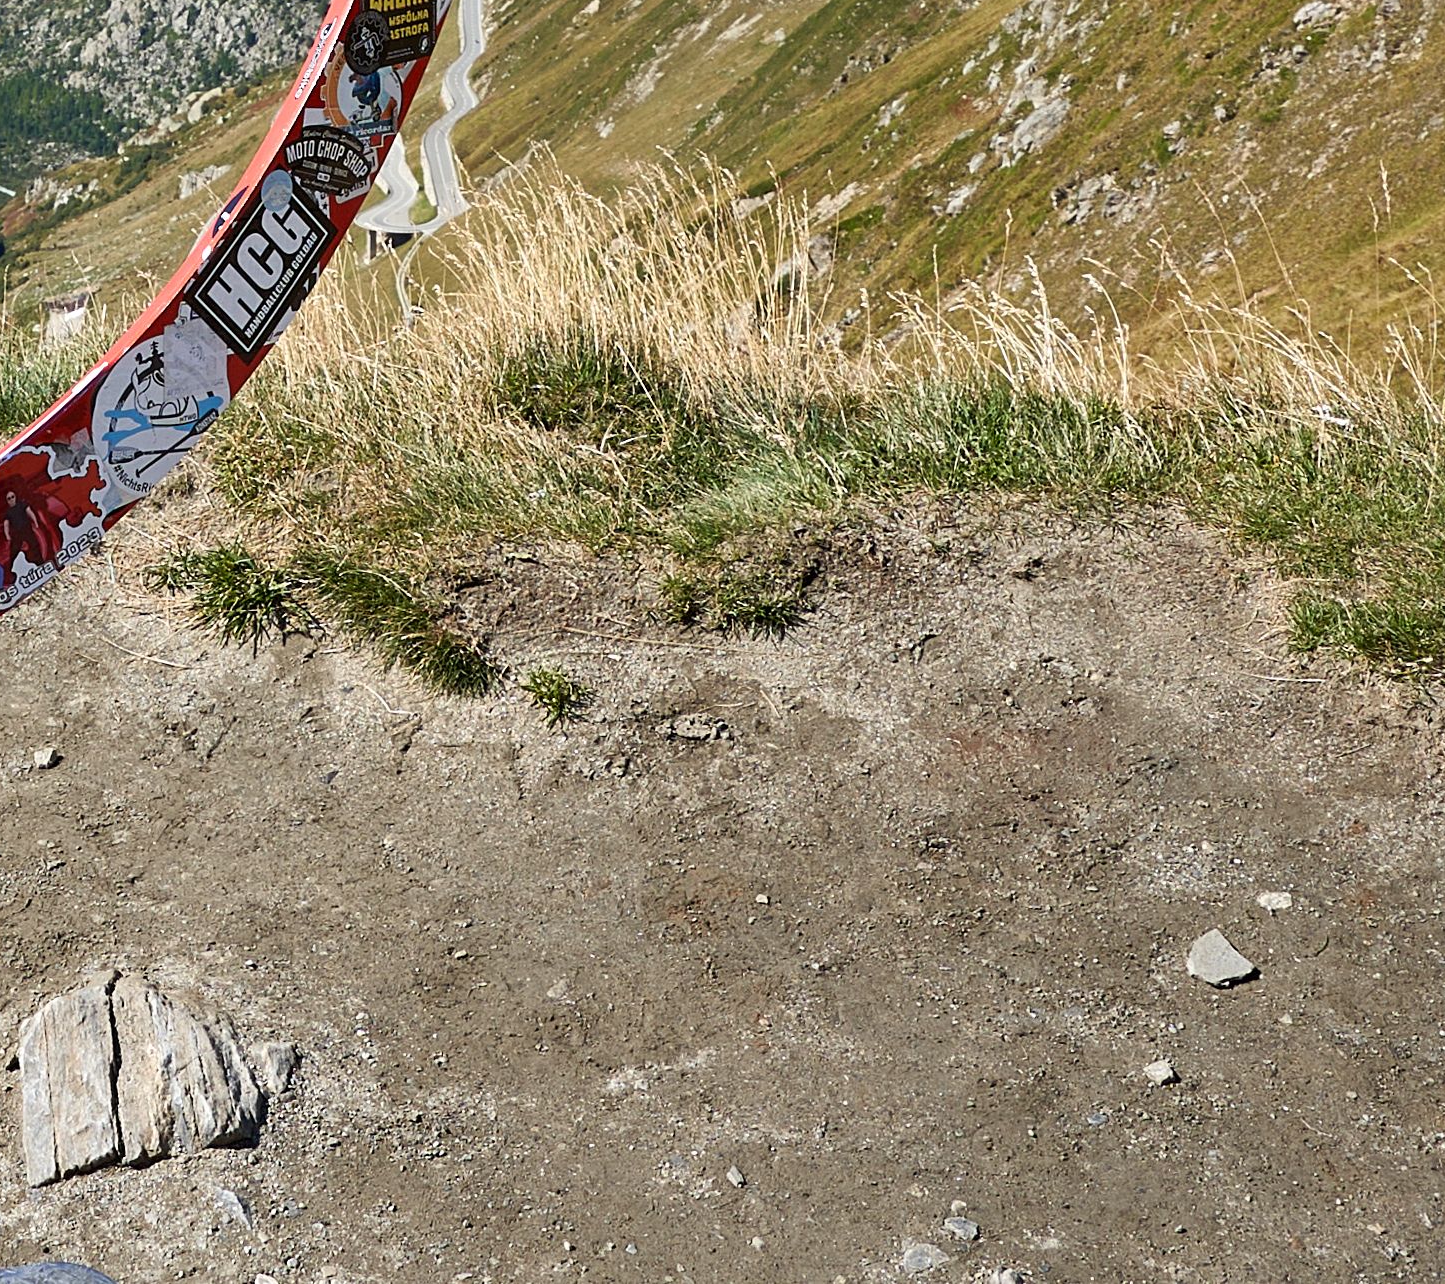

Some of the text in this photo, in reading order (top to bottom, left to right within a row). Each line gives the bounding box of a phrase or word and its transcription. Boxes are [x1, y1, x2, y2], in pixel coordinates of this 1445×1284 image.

[285, 139, 314, 164] MOTO
[316, 140, 344, 159] CHOP
[343, 152, 370, 178] SHOP
[207, 204, 311, 332] HCG
[244, 232, 319, 340] HANDBALLCLUB GOLDAU
[20, 561, 55, 590] túra
[56, 526, 102, 564] 2023
